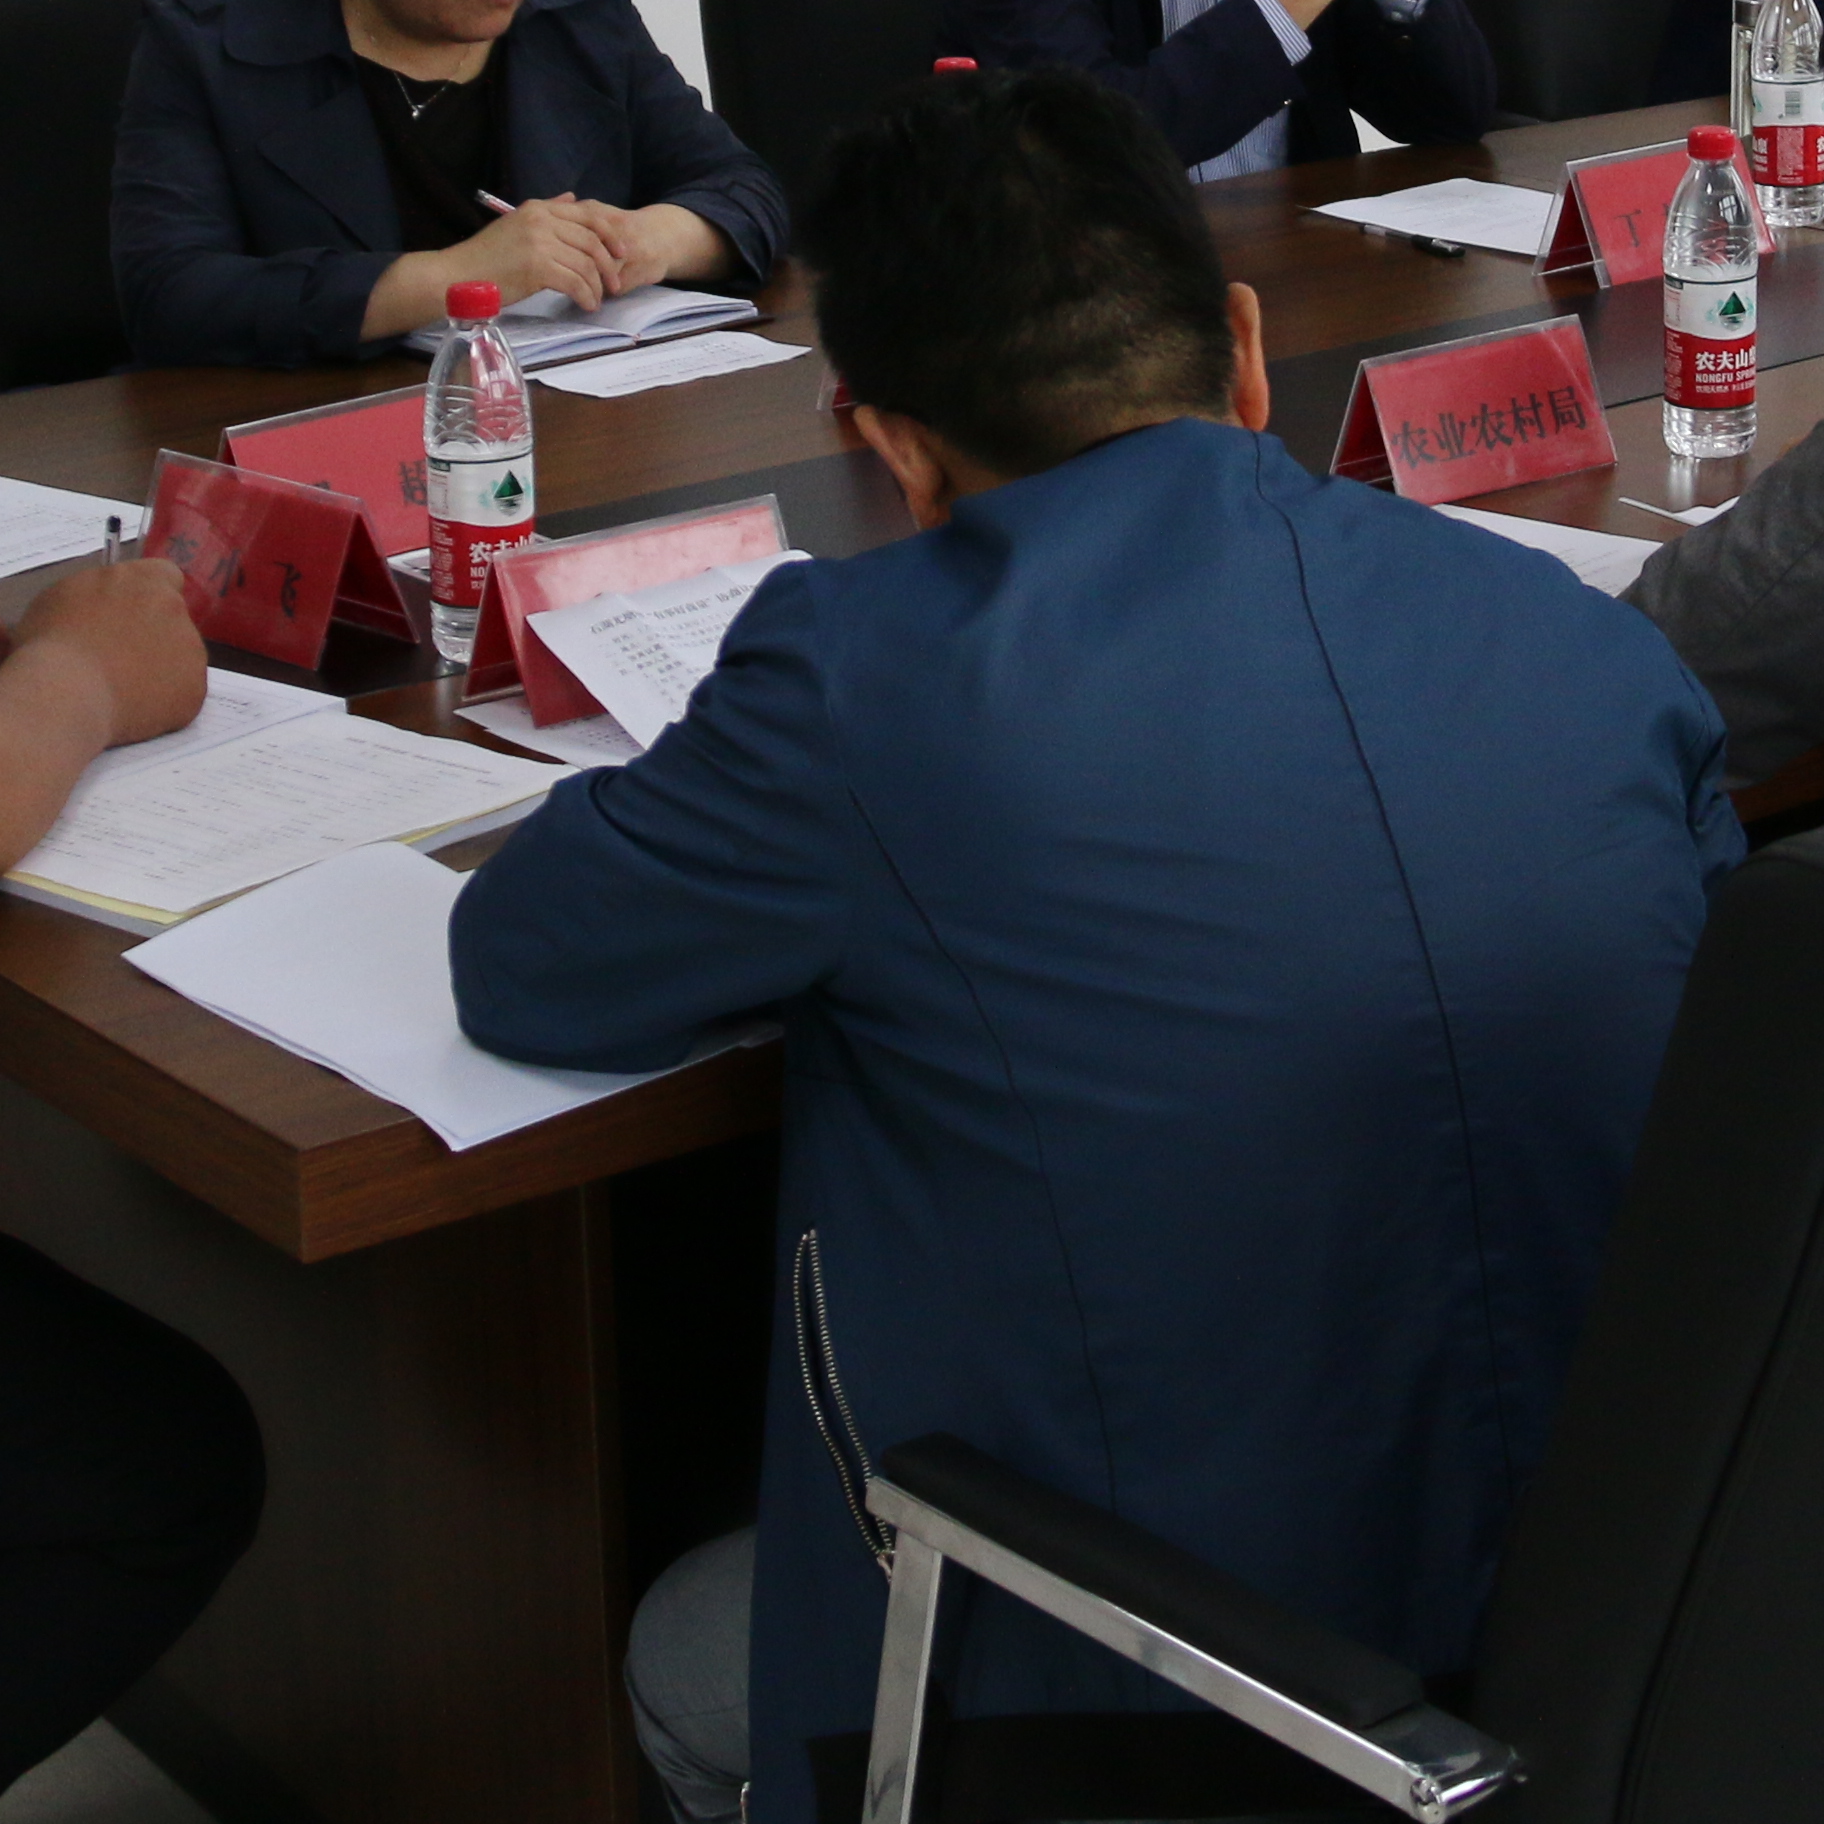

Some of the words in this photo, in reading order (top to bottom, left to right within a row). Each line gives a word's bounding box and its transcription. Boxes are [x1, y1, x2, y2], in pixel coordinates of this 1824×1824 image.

[1695, 373, 1733, 384] NONGFU
[1392, 386, 1586, 469] 农业农村局
